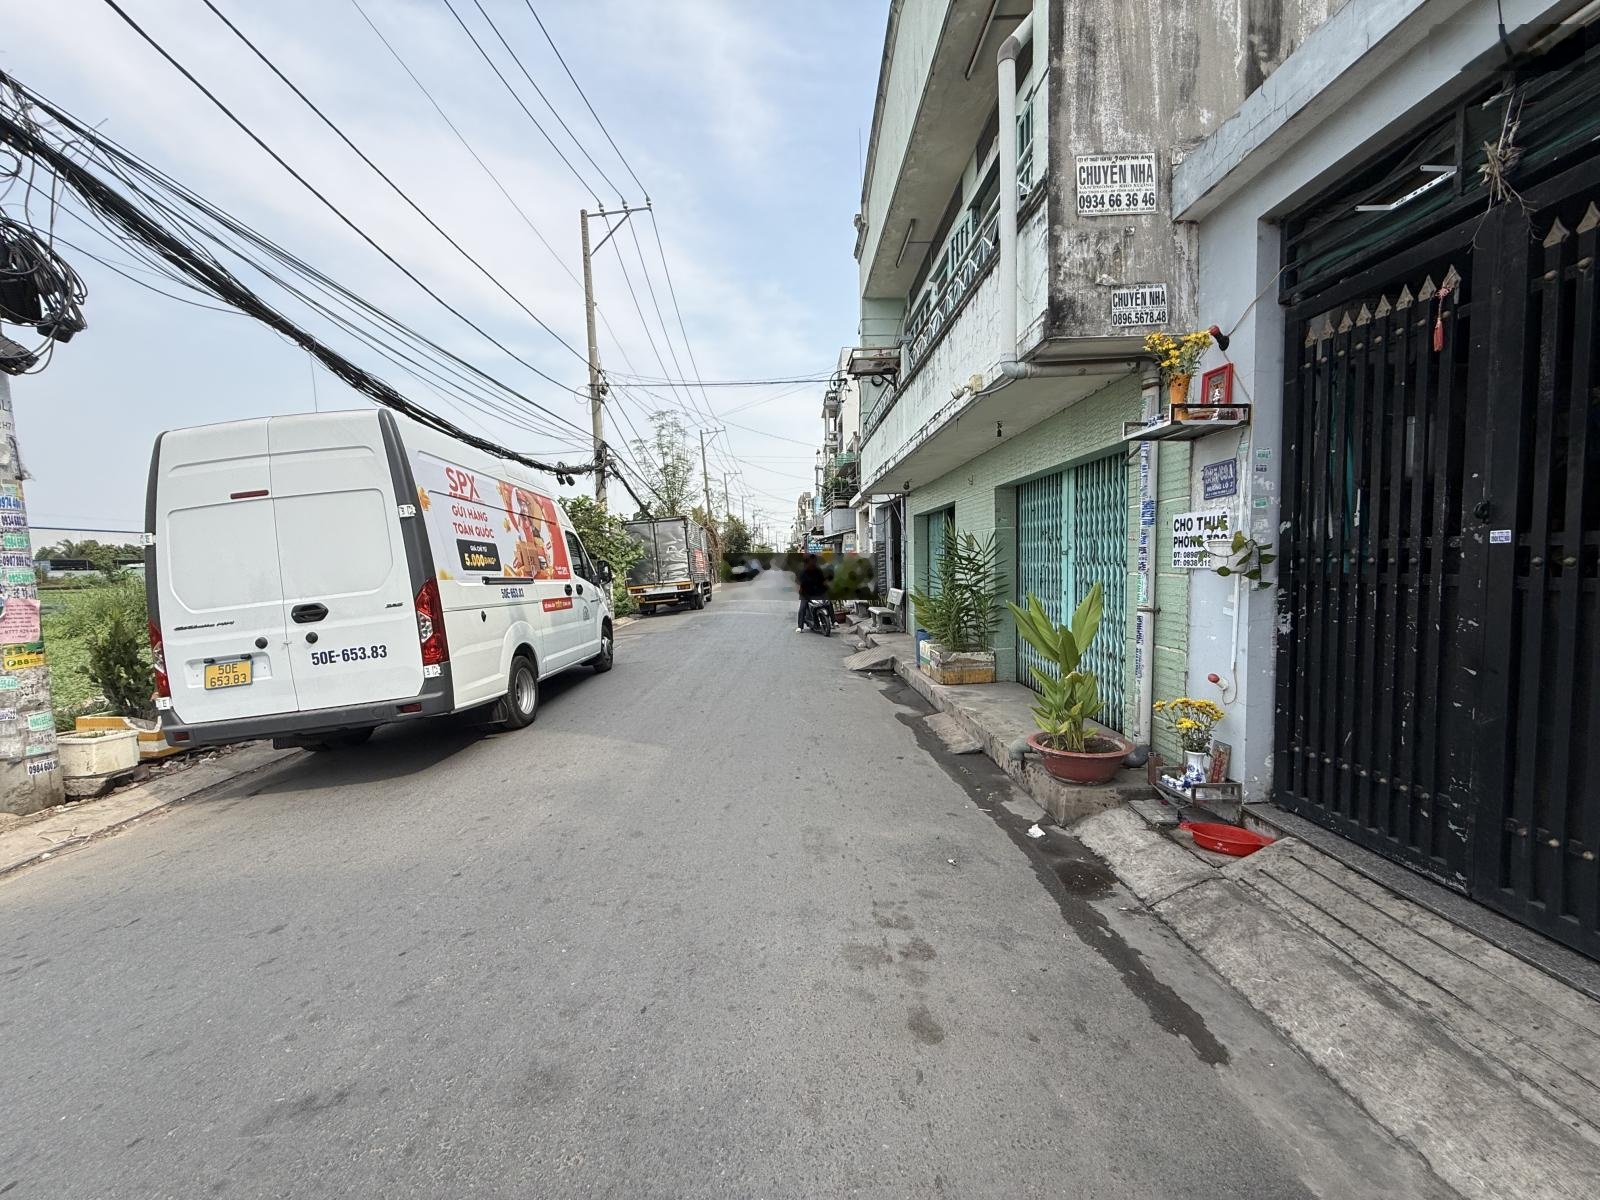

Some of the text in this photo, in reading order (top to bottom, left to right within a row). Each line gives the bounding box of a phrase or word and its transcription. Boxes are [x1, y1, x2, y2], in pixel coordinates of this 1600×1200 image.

[1079, 157, 1154, 185] CHUYỂN NHÀ
[1079, 192, 1155, 209] 0934 66 36 46
[1113, 286, 1166, 307] CHUYỂN NHÀ
[1113, 311, 1167, 325] 0896.5678.48
[445, 466, 480, 501] SPX
[452, 503, 488, 522] GỬI HÀNG
[453, 521, 495, 538] TOÀN QUỐC
[1173, 517, 1193, 532] CHO
[464, 553, 485, 567] 5.000
[311, 644, 388, 666] 50E-653.83
[217, 663, 238, 675] 50E
[210, 673, 247, 687] 653.83
